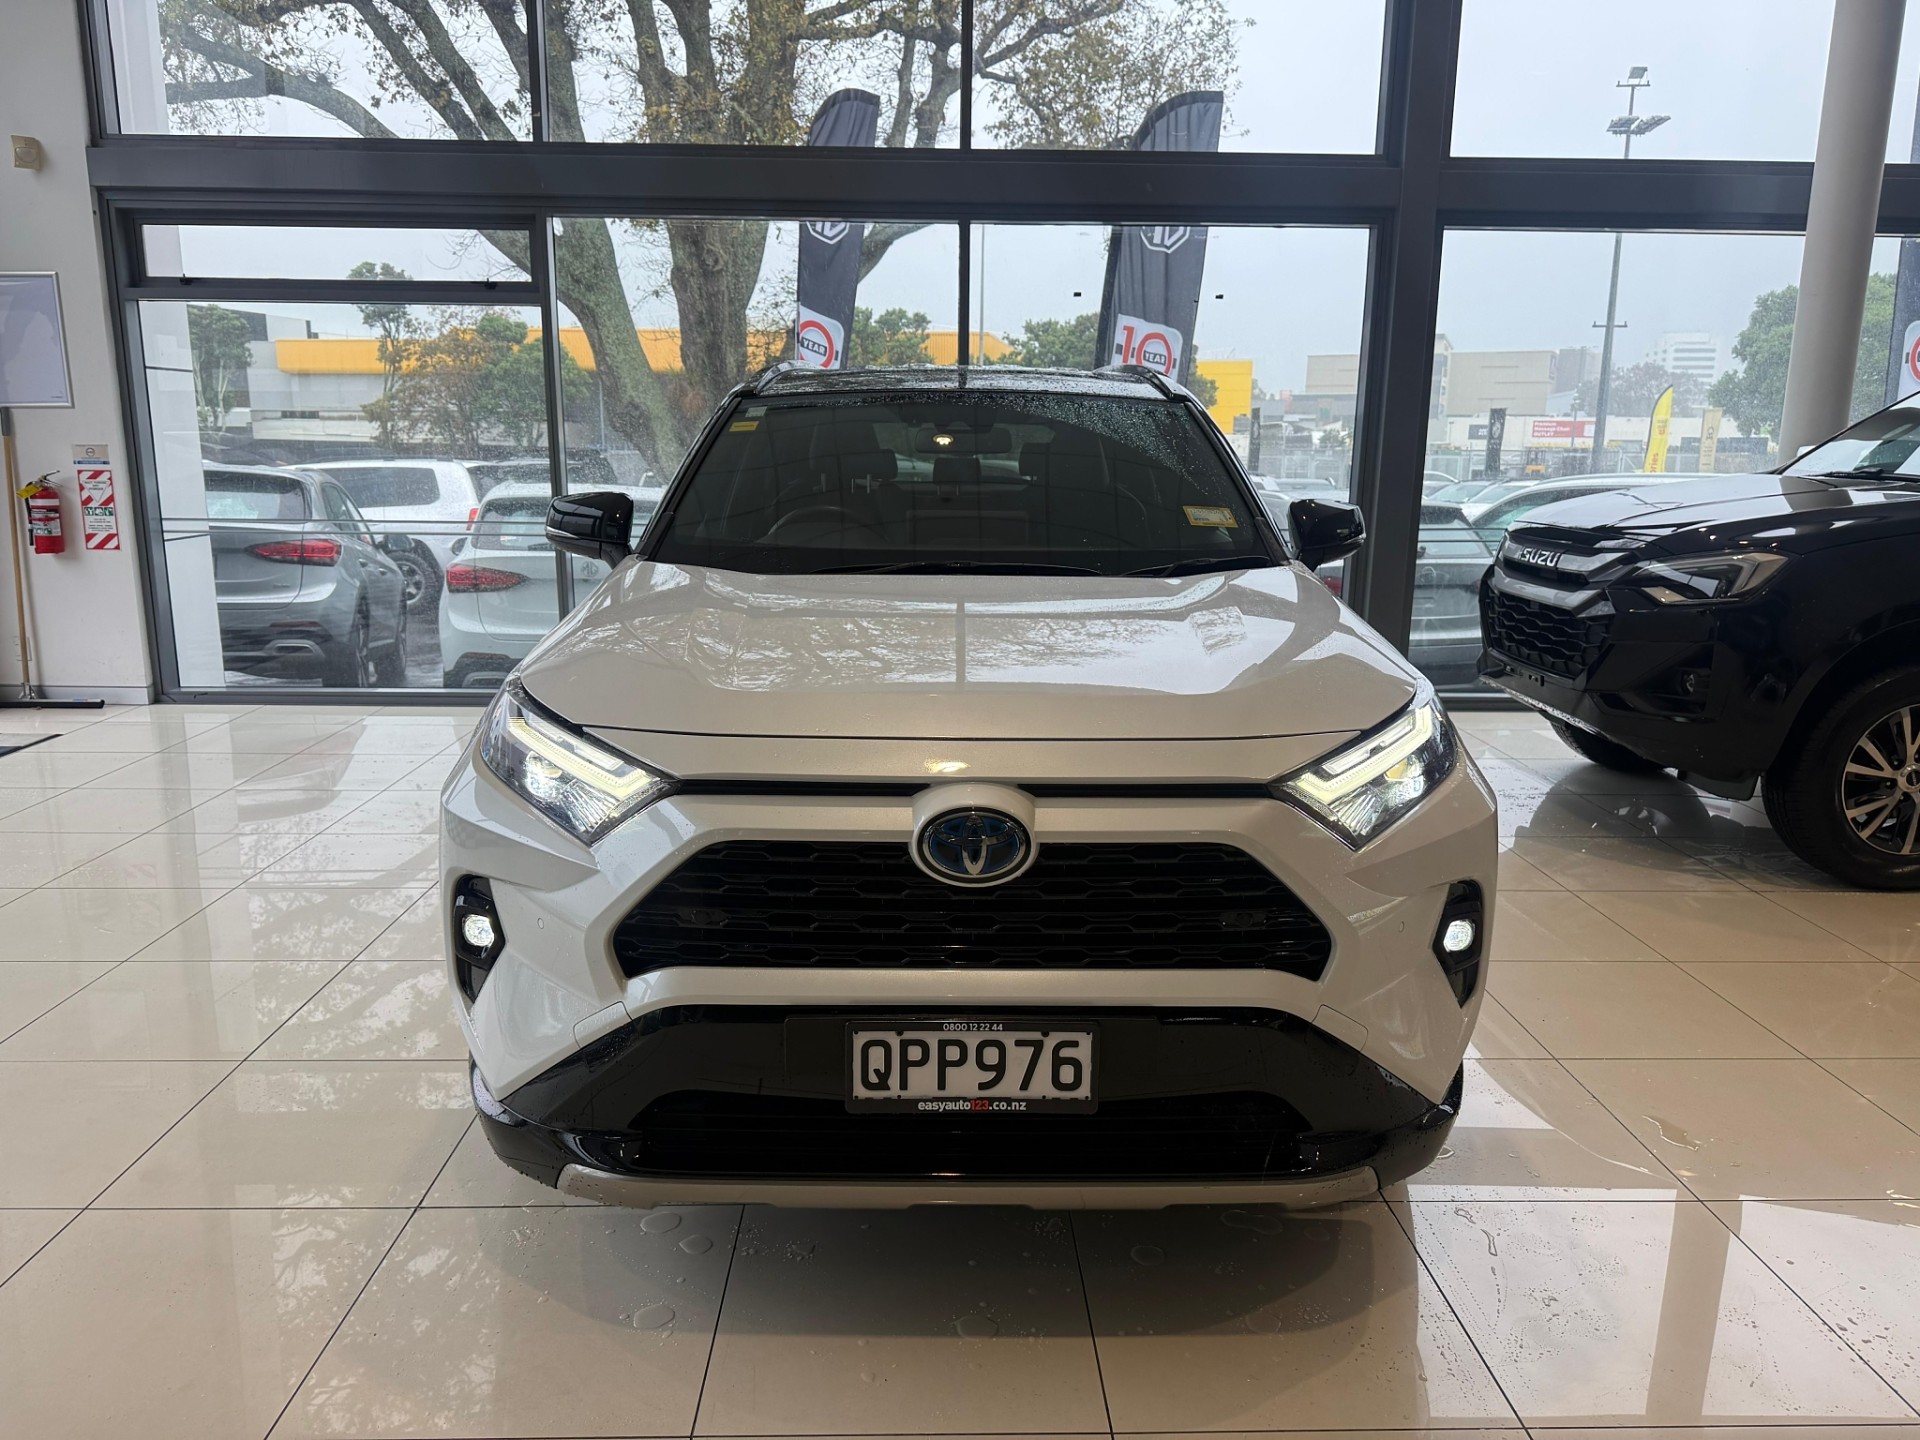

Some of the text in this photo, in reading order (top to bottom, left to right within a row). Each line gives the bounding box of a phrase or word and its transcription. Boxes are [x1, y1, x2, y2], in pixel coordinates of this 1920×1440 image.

[803, 338, 826, 355] YEAR
[1123, 325, 1173, 376] 10
[1145, 351, 1166, 365] YEAR
[1519, 546, 1561, 567] ISUZU
[942, 1022, 1004, 1031] 0800 12 22 44
[860, 1038, 1083, 1092] QPP976
[917, 1099, 1027, 1112] easyauto123.co.nz
